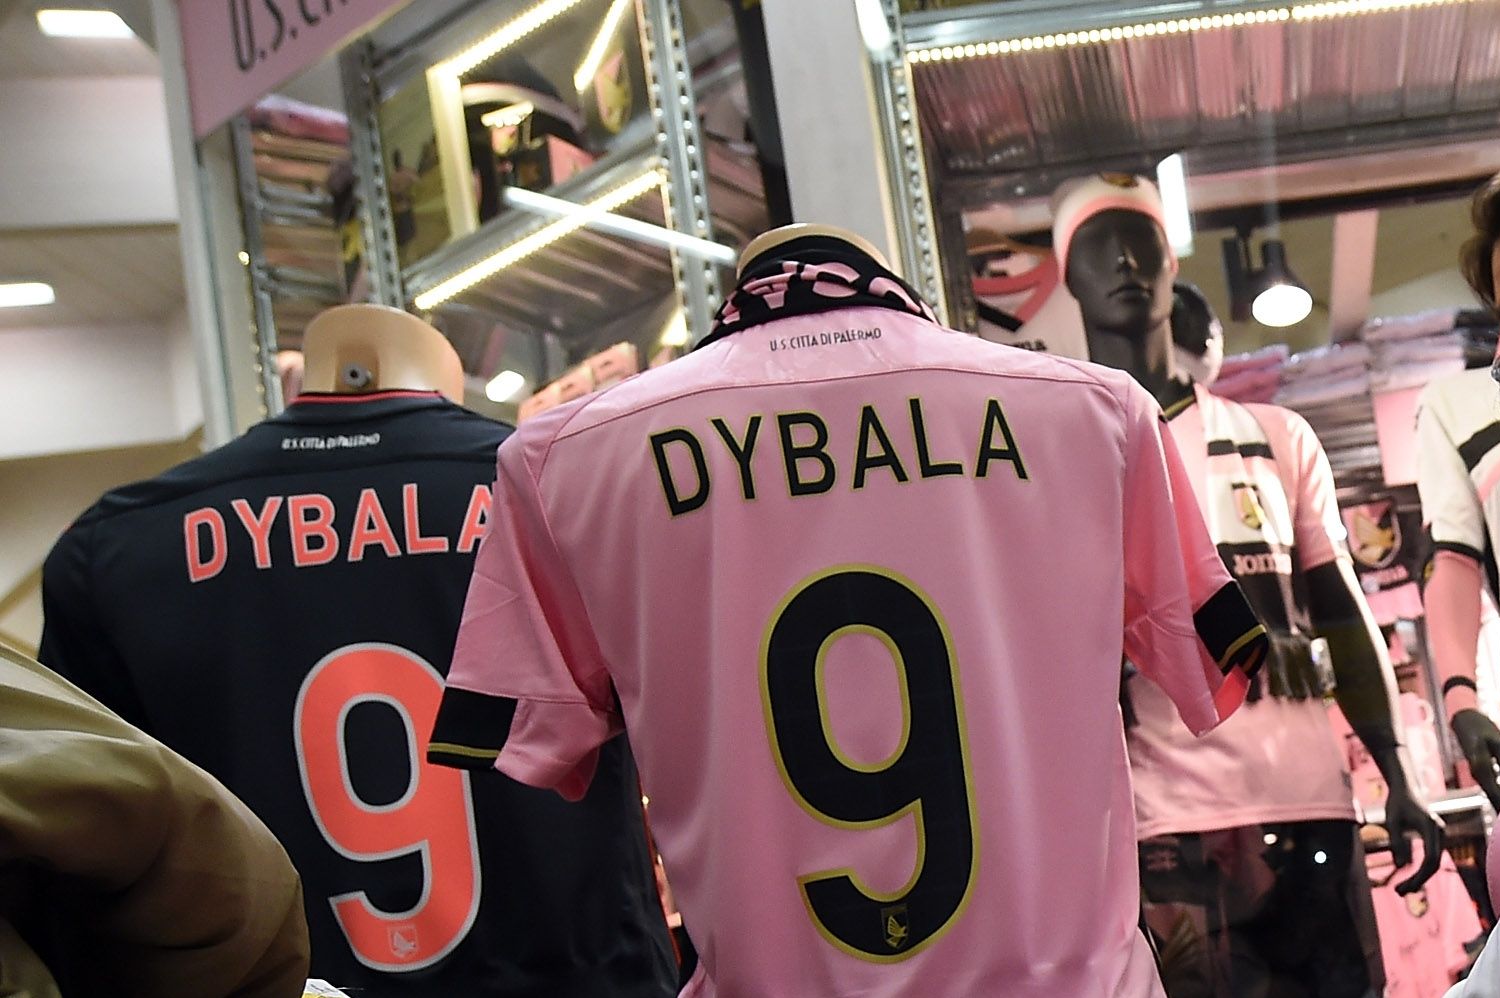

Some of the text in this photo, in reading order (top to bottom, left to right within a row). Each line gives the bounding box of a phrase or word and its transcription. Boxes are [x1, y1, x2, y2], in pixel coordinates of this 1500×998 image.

[833, 327, 882, 344] PALERMO
[648, 396, 1032, 520] DYBALA
[184, 483, 494, 582] DYBALA
[294, 642, 482, 972] 9
[757, 563, 981, 965] 9
